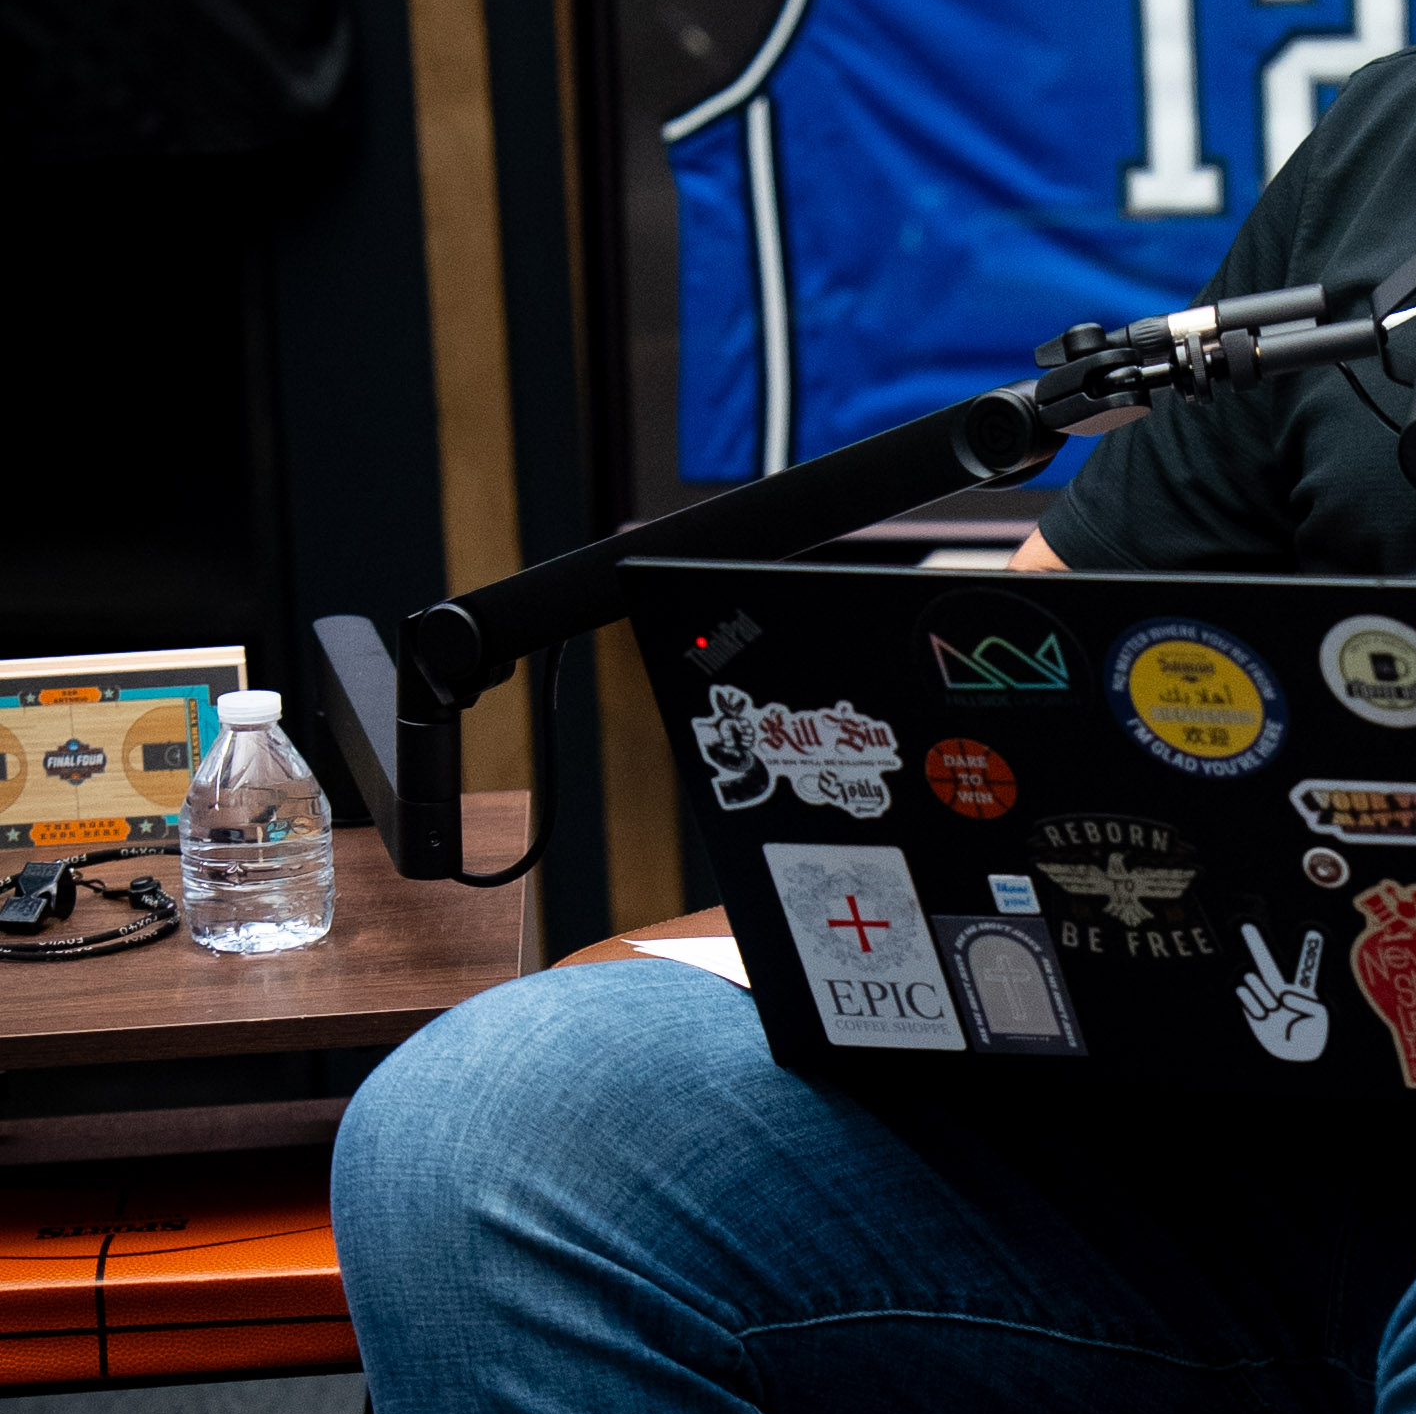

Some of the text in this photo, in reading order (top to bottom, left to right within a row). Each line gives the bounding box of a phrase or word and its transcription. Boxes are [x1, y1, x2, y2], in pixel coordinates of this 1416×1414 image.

[683, 607, 764, 677] ThinkPad
[757, 707, 891, 755] Kill Sin
[47, 753, 104, 768] FINAL FOUR
[943, 754, 987, 768] DARE
[1150, 739, 1199, 773] GLAD
[957, 773, 983, 786] TO
[956, 791, 994, 804] WIN
[1312, 790, 1388, 811] YOUR
[1043, 820, 1169, 852] REBORN
[1061, 920, 1214, 959] BE FREE
[823, 979, 944, 1020] EPIC
[835, 1020, 948, 1035] COFFEE SHOPPE
[35, 1218, 190, 1240] SPORTS
